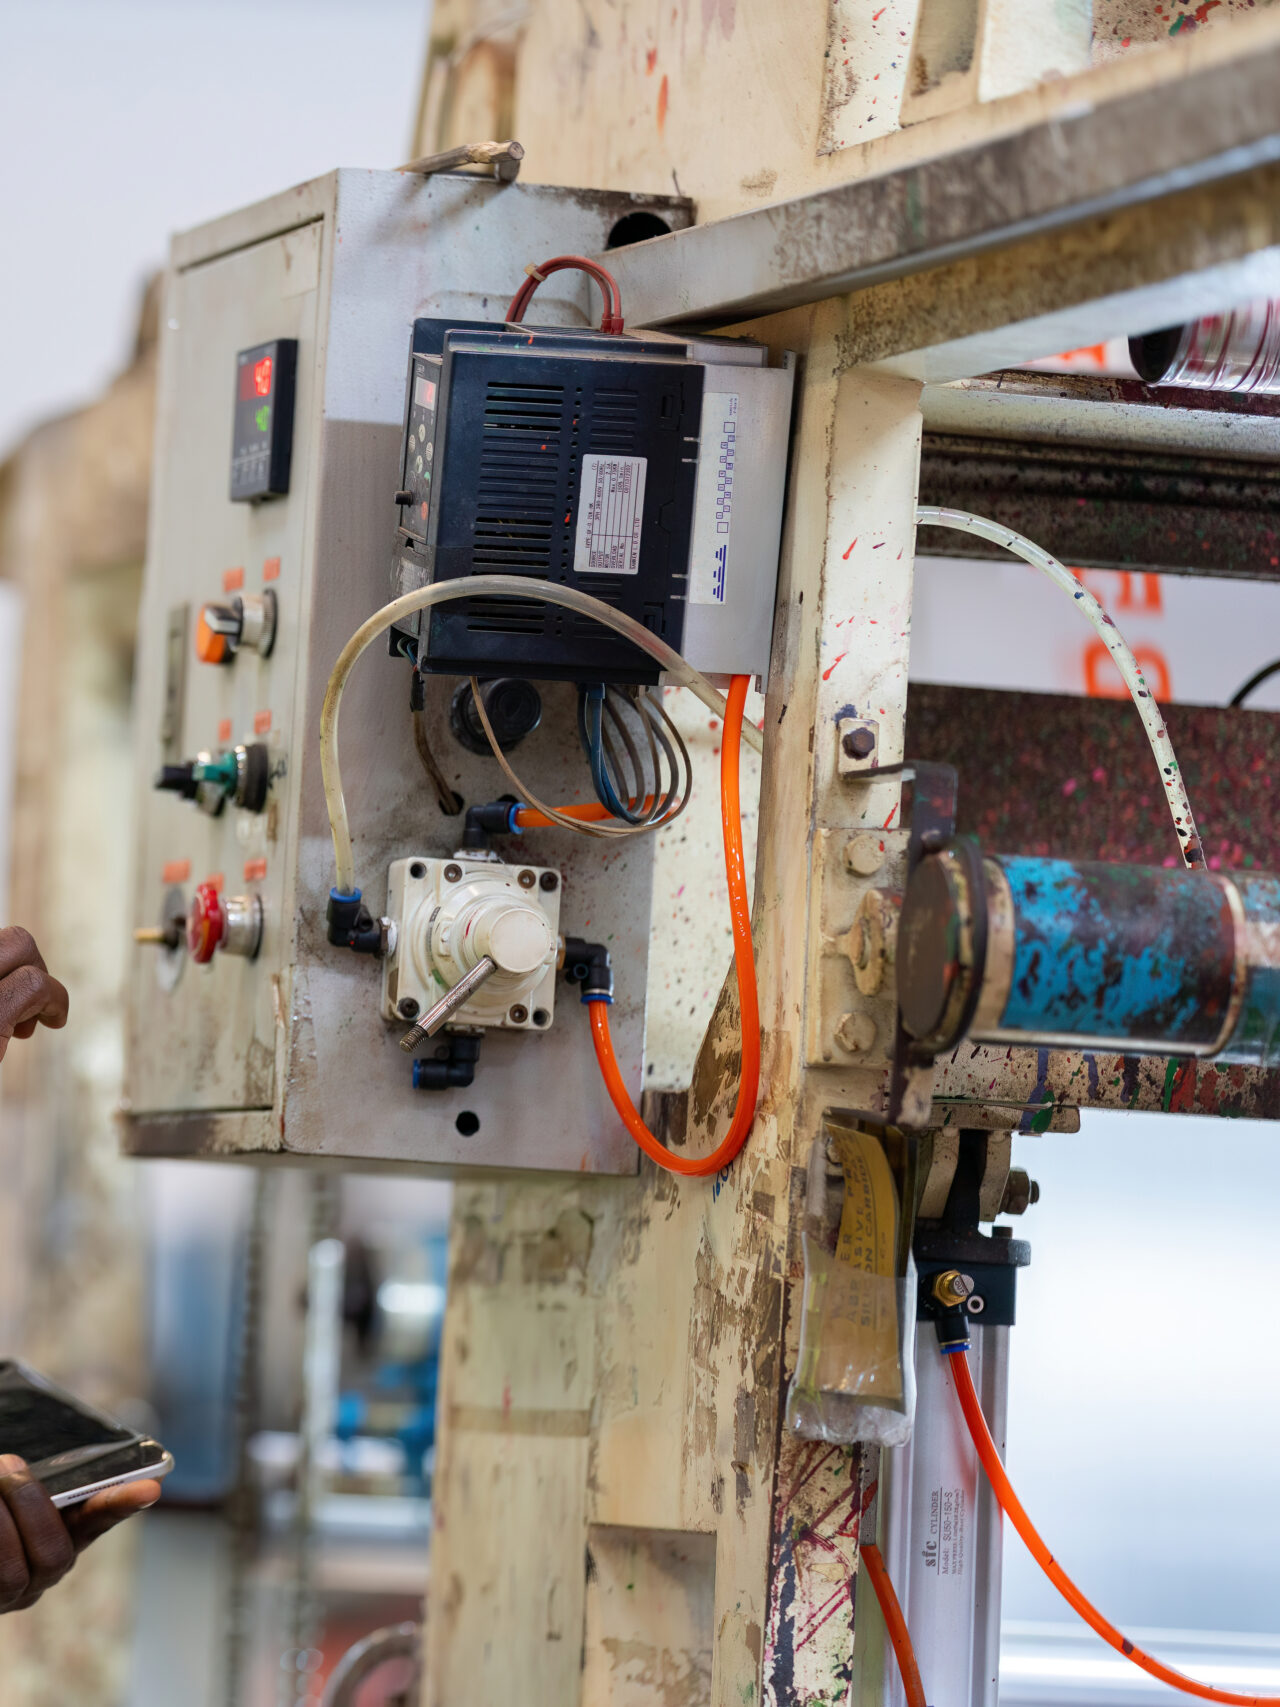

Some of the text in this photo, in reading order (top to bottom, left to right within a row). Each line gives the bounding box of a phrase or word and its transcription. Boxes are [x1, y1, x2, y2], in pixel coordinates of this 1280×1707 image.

[954, 1280, 965, 1295] OUT
[922, 1490, 939, 1567] sfc CYLINDER
[943, 1491, 953, 1542] SU50-150-S
